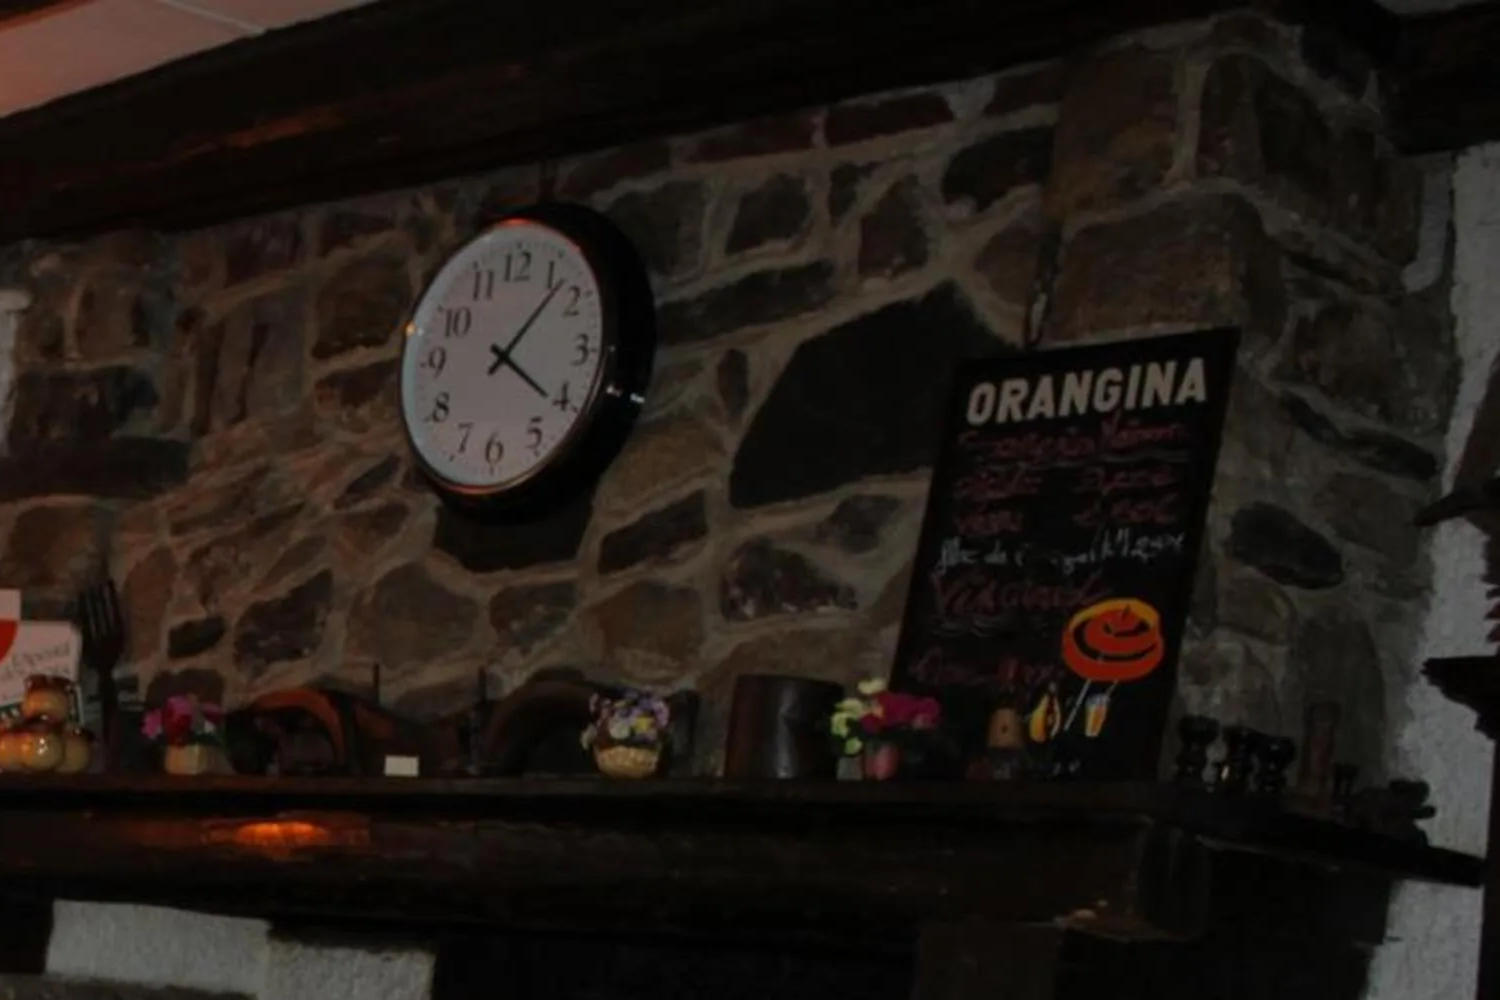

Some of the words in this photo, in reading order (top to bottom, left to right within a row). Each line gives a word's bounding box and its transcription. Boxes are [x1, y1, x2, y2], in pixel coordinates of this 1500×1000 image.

[503, 252, 531, 283] 12
[473, 270, 495, 300] 11
[563, 286, 581, 317] 2
[444, 306, 472, 338] 10
[428, 346, 446, 378] 9
[571, 334, 589, 367] 3
[552, 382, 569, 412] 4
[966, 356, 1208, 426] ORANGINA
[431, 392, 449, 423] 8
[458, 422, 475, 453] 7
[484, 431, 504, 465] 6
[526, 417, 543, 449] 5
